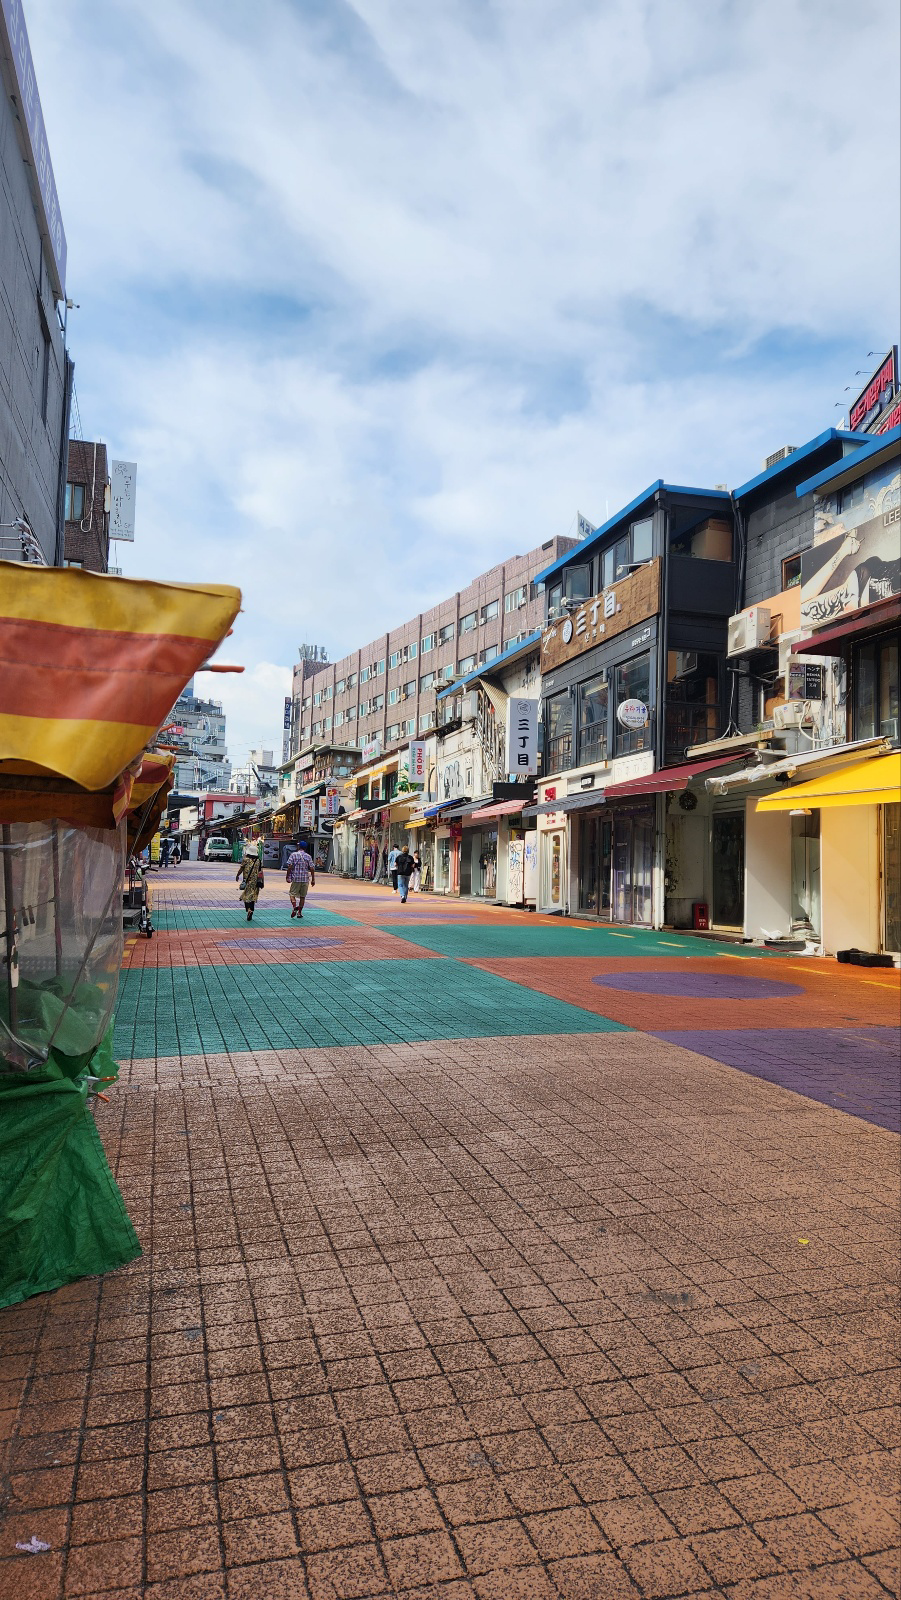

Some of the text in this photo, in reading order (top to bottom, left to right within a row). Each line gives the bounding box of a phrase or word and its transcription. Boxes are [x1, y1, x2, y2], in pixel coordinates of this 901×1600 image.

[851, 358, 893, 432] 보드게임카페
[576, 592, 617, 636] 三丁目
[518, 719, 529, 766] 三丁目
